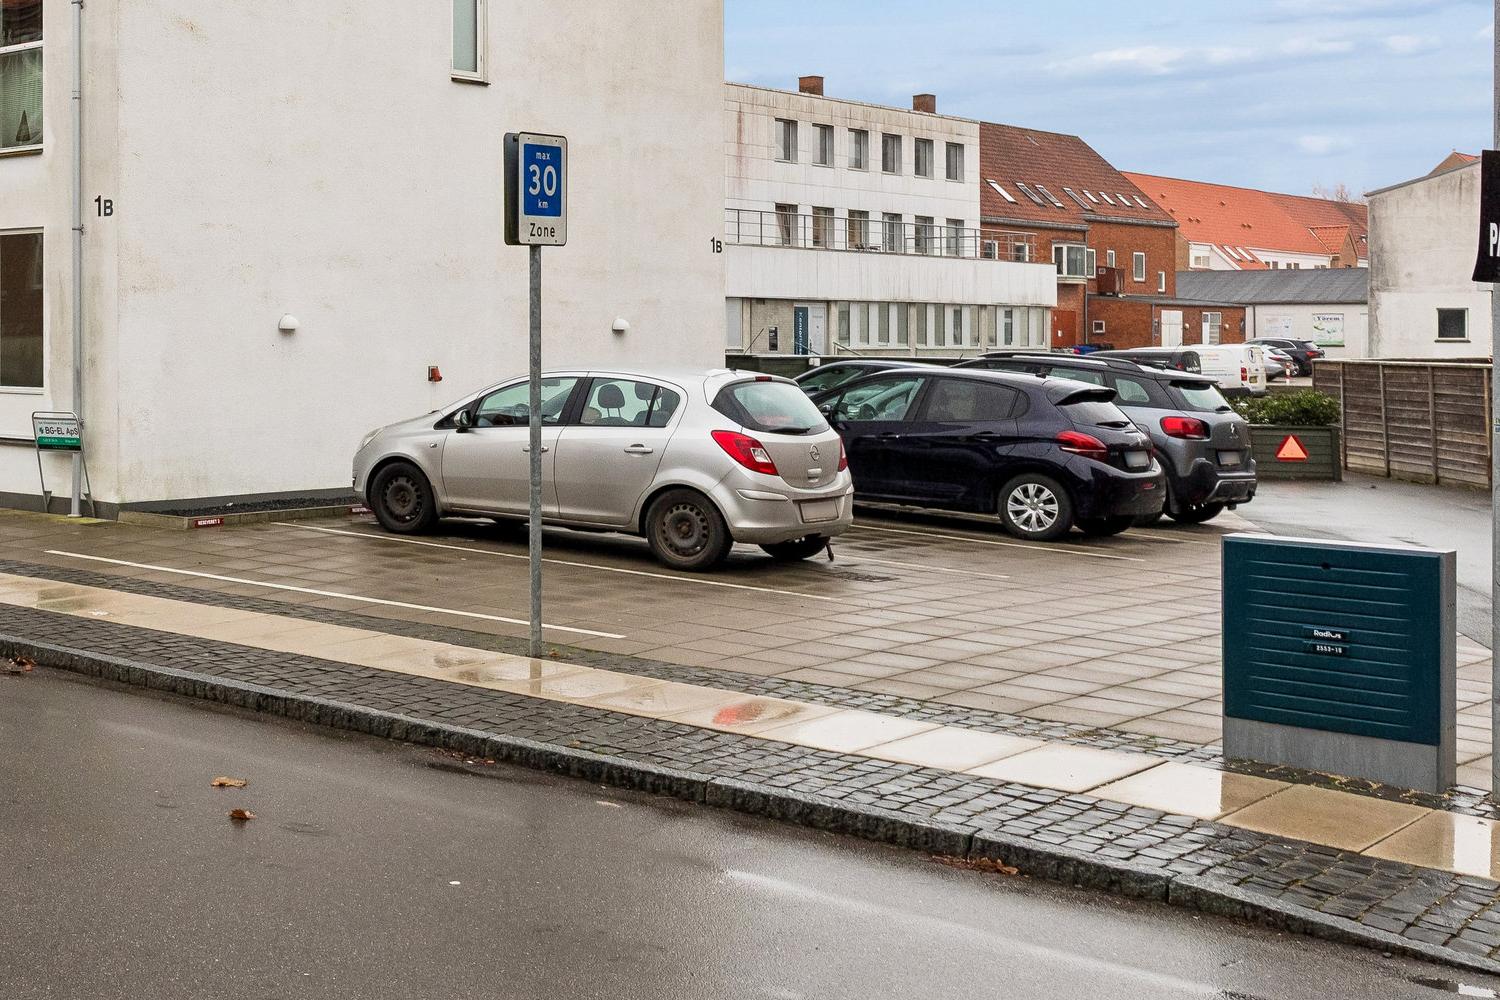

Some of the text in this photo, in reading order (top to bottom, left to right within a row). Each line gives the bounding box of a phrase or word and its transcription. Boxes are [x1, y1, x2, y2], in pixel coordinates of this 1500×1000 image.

[535, 151, 551, 161] max
[528, 164, 557, 197] 30
[94, 195, 114, 217] 1B
[537, 199, 549, 209] km
[529, 222, 556, 238] Zone
[710, 236, 723, 254] 1B
[1489, 222, 1500, 257] P
[45, 426, 79, 437] BG-EL ApS
[1313, 629, 1342, 639] Radius
